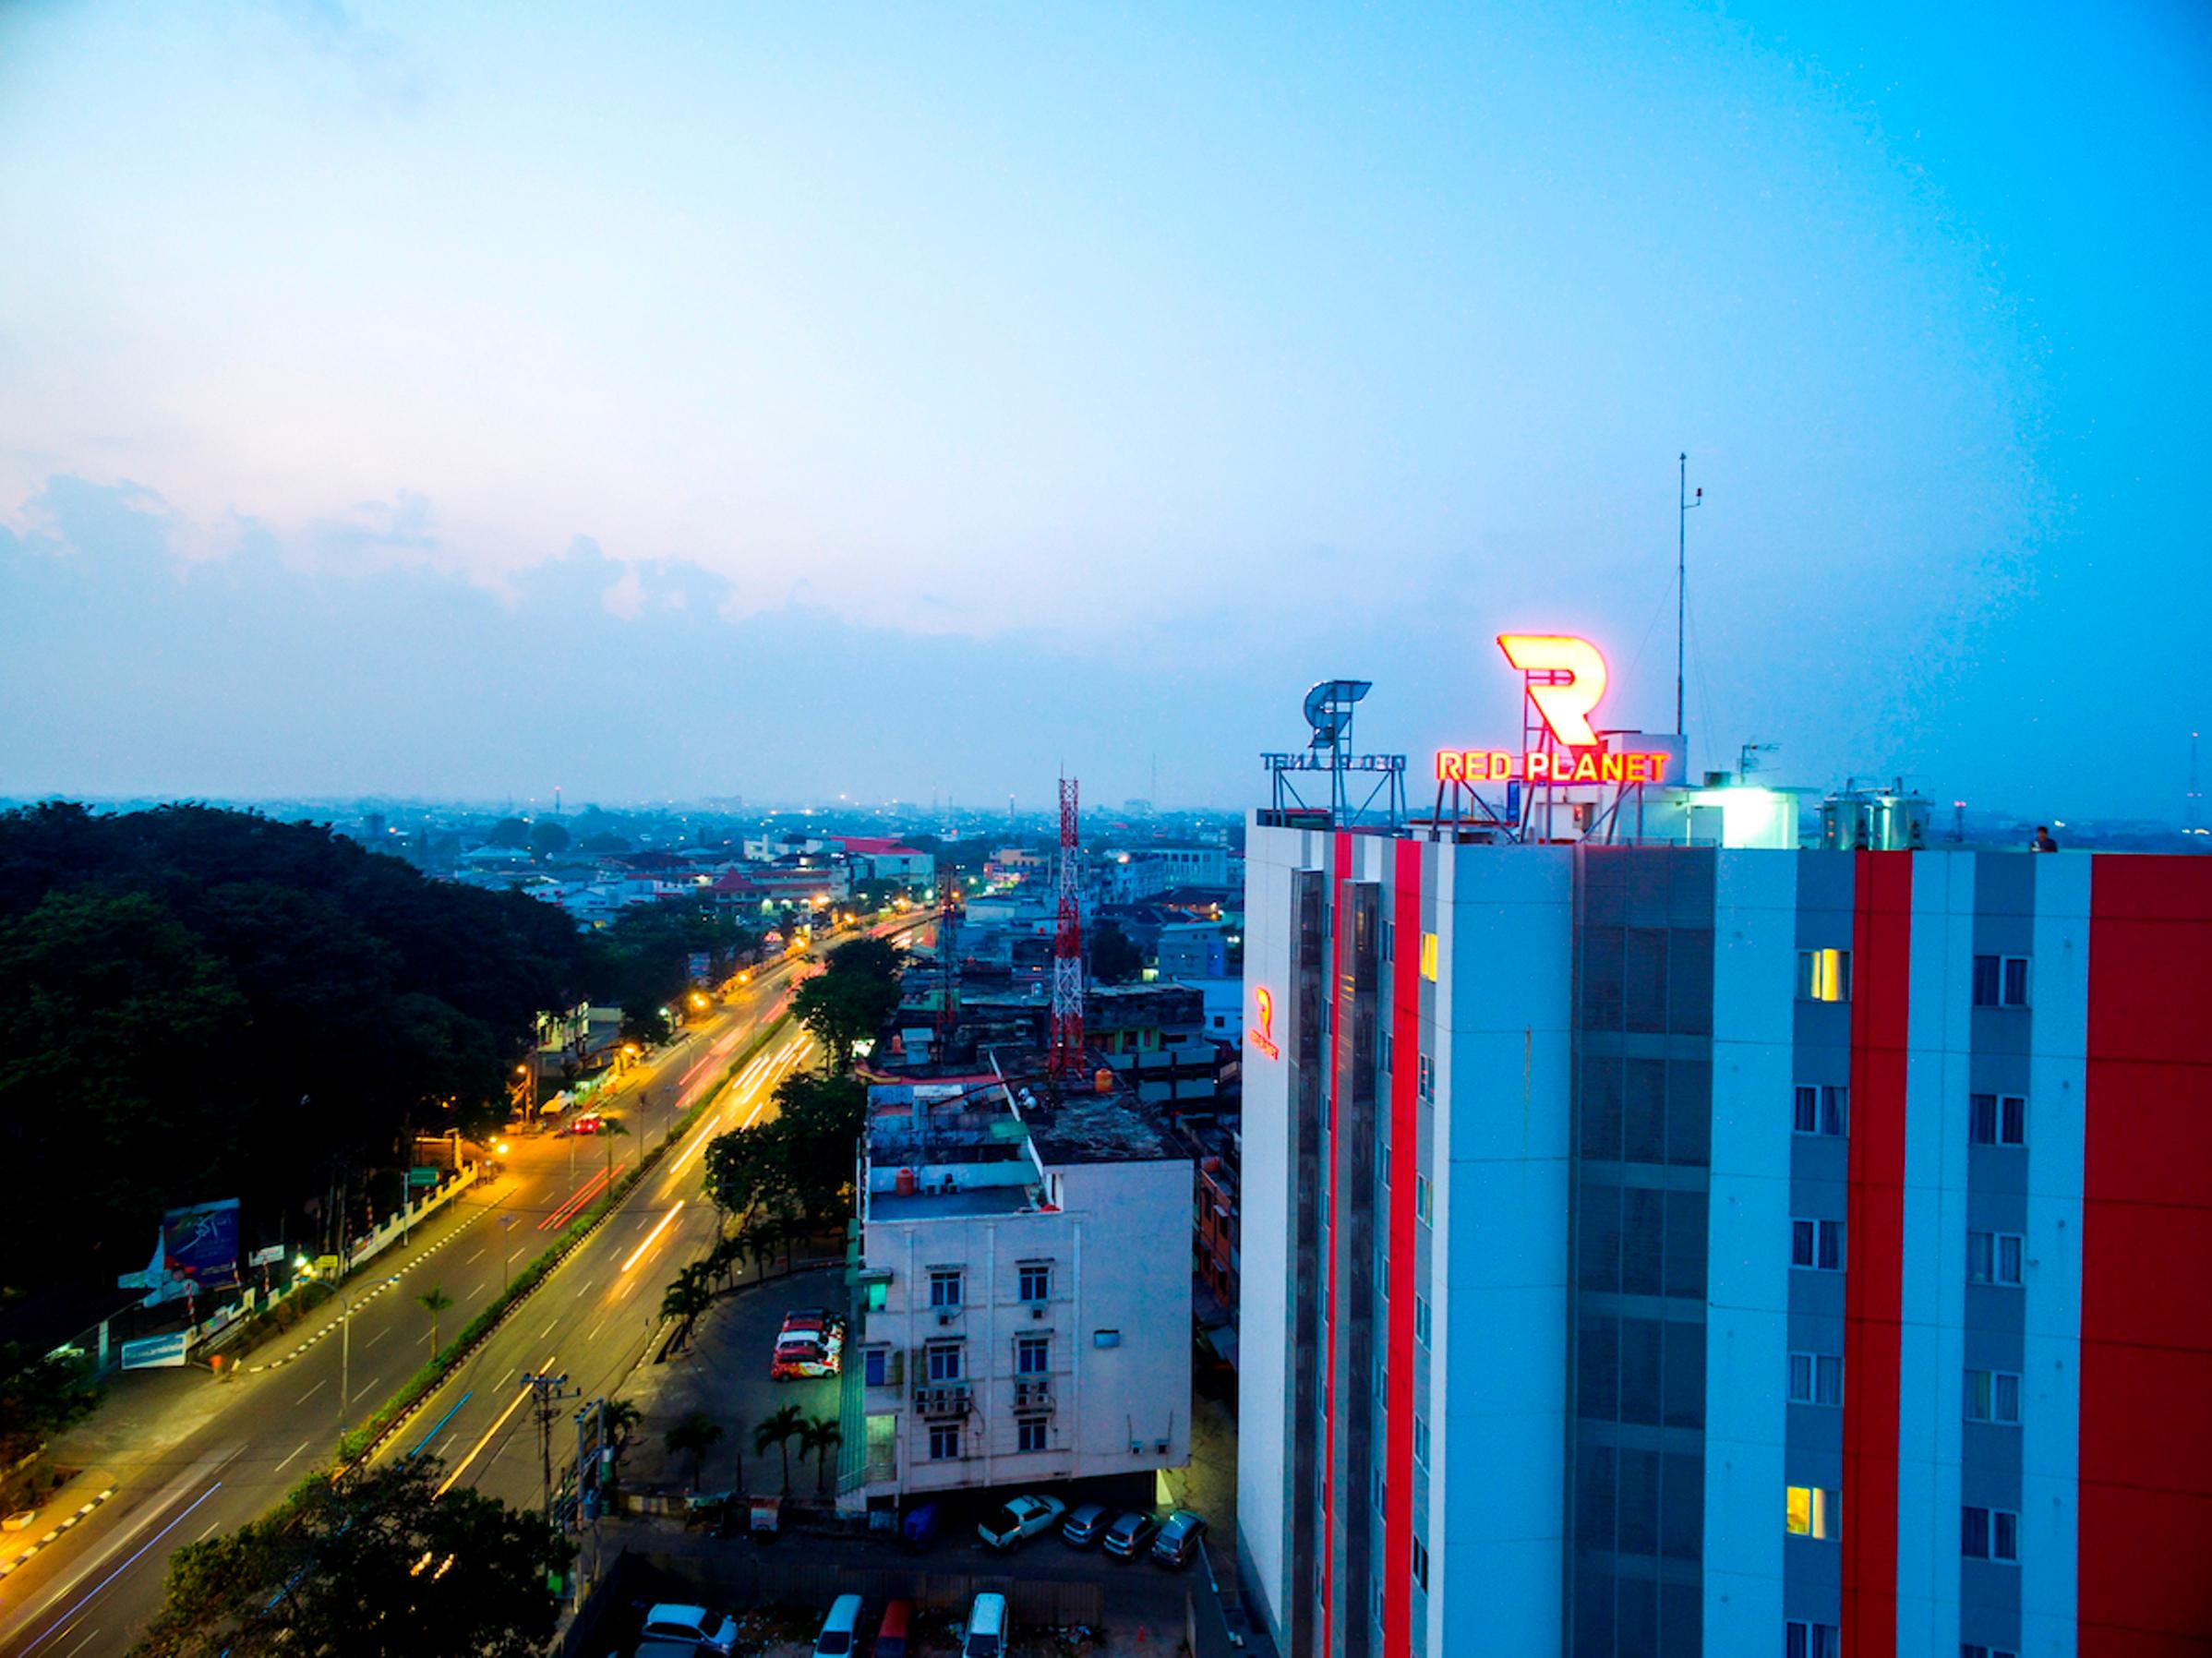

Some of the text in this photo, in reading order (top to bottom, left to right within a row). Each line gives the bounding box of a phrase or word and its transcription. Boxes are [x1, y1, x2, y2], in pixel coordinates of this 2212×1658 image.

[1497, 634, 1608, 746] R
[1437, 751, 1671, 782] RED PLANET
